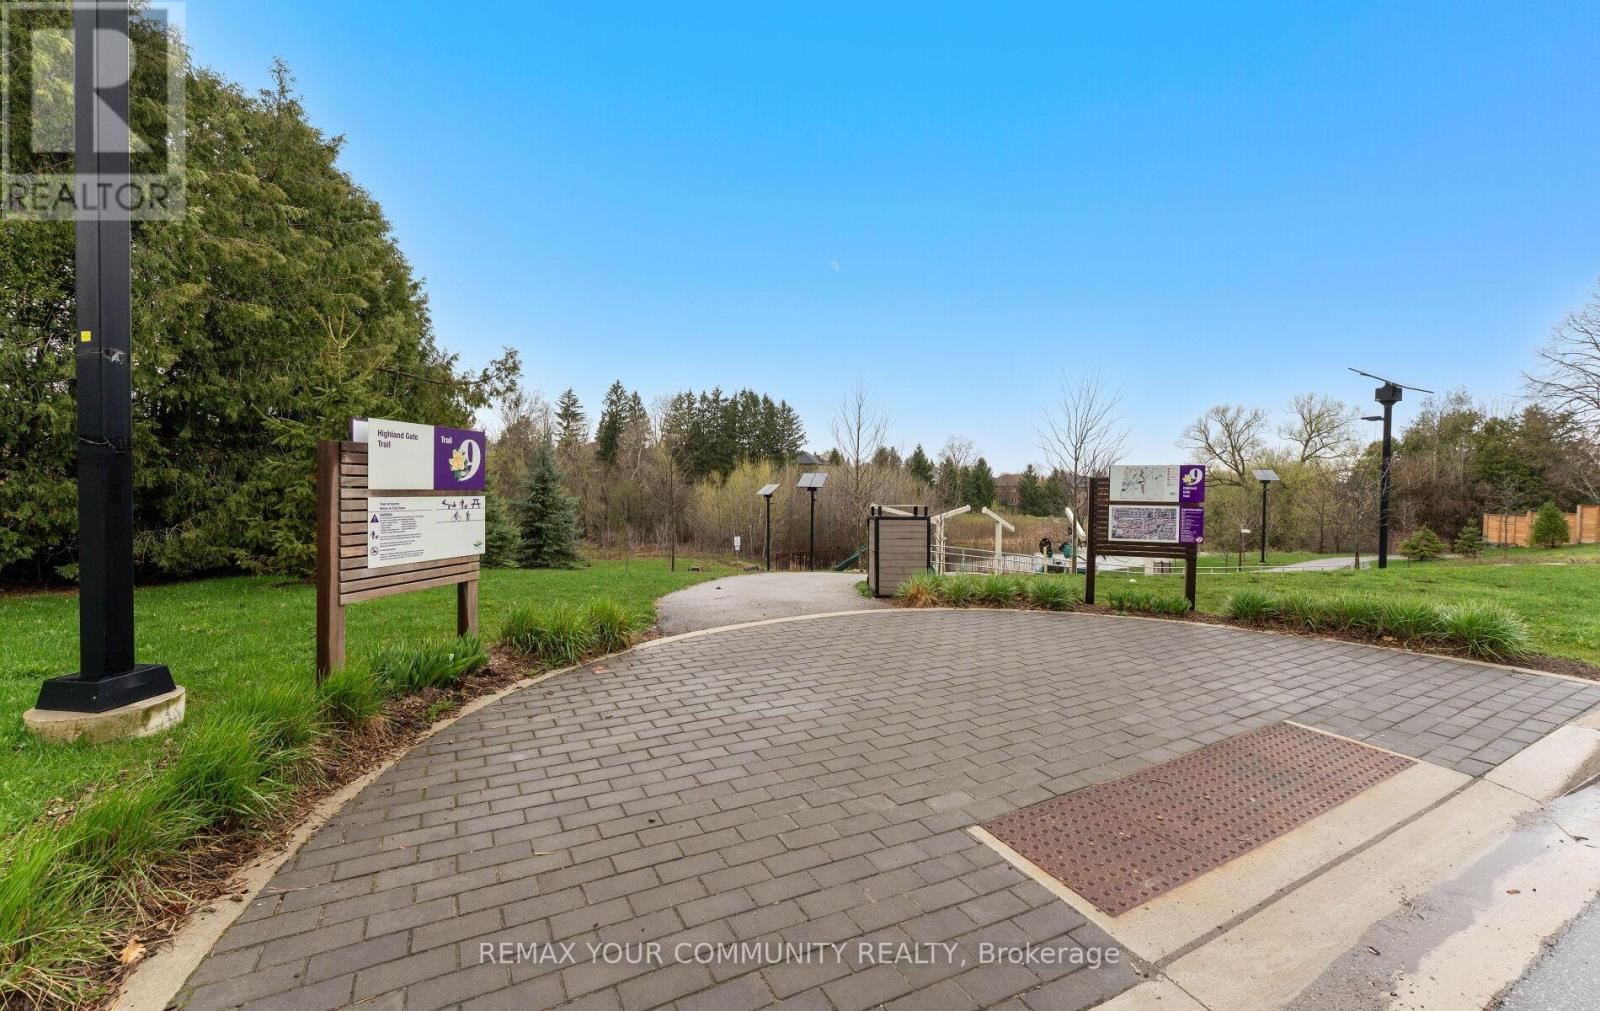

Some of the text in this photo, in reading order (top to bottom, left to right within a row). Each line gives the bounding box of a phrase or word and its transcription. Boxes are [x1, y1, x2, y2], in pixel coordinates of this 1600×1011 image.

[377, 429, 419, 441] Highland Gate
[441, 435, 453, 444] Trail
[377, 439, 391, 448] Trail
